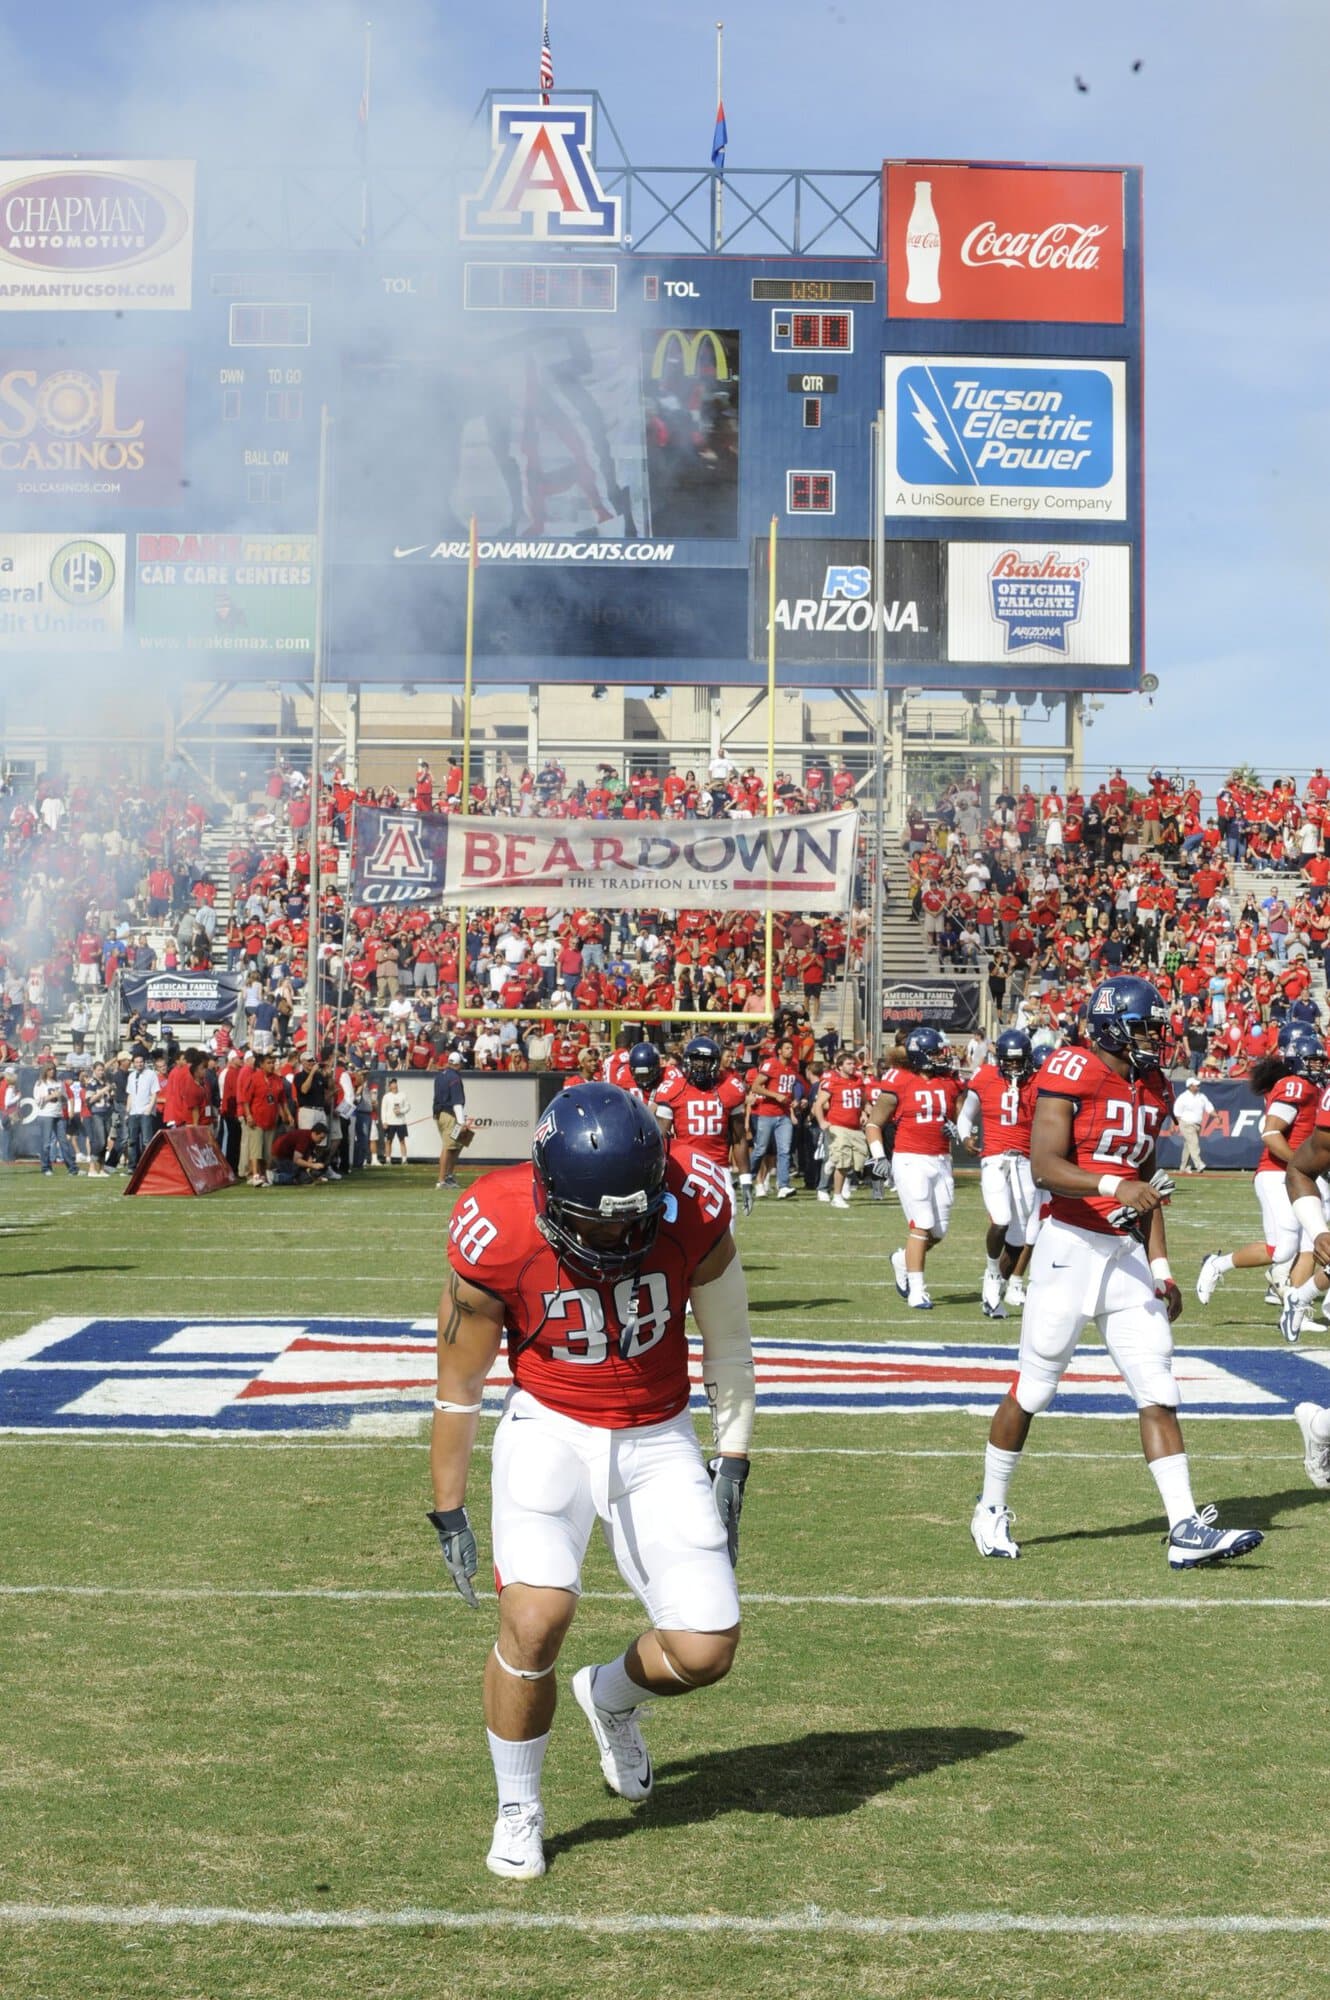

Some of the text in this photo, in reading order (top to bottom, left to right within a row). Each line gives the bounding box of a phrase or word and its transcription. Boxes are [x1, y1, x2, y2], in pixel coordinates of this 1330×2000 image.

[6, 197, 146, 232] CHAPMAN
[9, 236, 145, 248] AUTOMOTIVE
[960, 221, 1108, 270] Coca-Cola
[0, 284, 175, 297] APMANTUCSON.COM
[383, 277, 416, 294] TOL
[663, 281, 700, 297] TOL
[791, 281, 832, 301] WSU
[793, 315, 849, 347] 00
[220, 369, 302, 384] DWN TO GO
[801, 375, 823, 391] QTR
[952, 381, 1063, 413] Tucson
[963, 411, 1093, 441] Electric
[0, 442, 144, 470] CASINOS
[245, 451, 288, 465] BALL ON
[976, 441, 1092, 470] Power
[17, 481, 120, 494] SOLCASINOS.COM
[895, 493, 1113, 512] A UniSource Energy Company
[431, 541, 675, 562] ARIZONAWILDCATS.COM
[141, 566, 311, 585] CAR CARE CENTERS
[991, 552, 1085, 578] Bashas'
[822, 565, 872, 600] FS
[998, 583, 1075, 596] OFFICIAL
[998, 597, 1075, 609] TAILGATE
[998, 609, 1075, 618] HEADQUARTERS
[766, 599, 920, 632] ARIZONA
[1011, 626, 1062, 637] ARIZONA
[569, 878, 728, 890] THE TRADITION LIVES
[148, 983, 187, 991] AMERICAN
[884, 992, 924, 1000] AMERICAN
[1047, 1050, 1088, 1081] 26
[841, 1088, 862, 1109] 66
[1283, 1081, 1303, 1099] 91
[915, 1089, 947, 1124] 31
[1000, 1091, 1019, 1126] 9
[687, 1100, 723, 1136] 52
[1092, 1100, 1159, 1168] 26
[681, 1152, 726, 1219] 38
[449, 1196, 499, 1265] 38
[543, 1272, 671, 1364] 38
